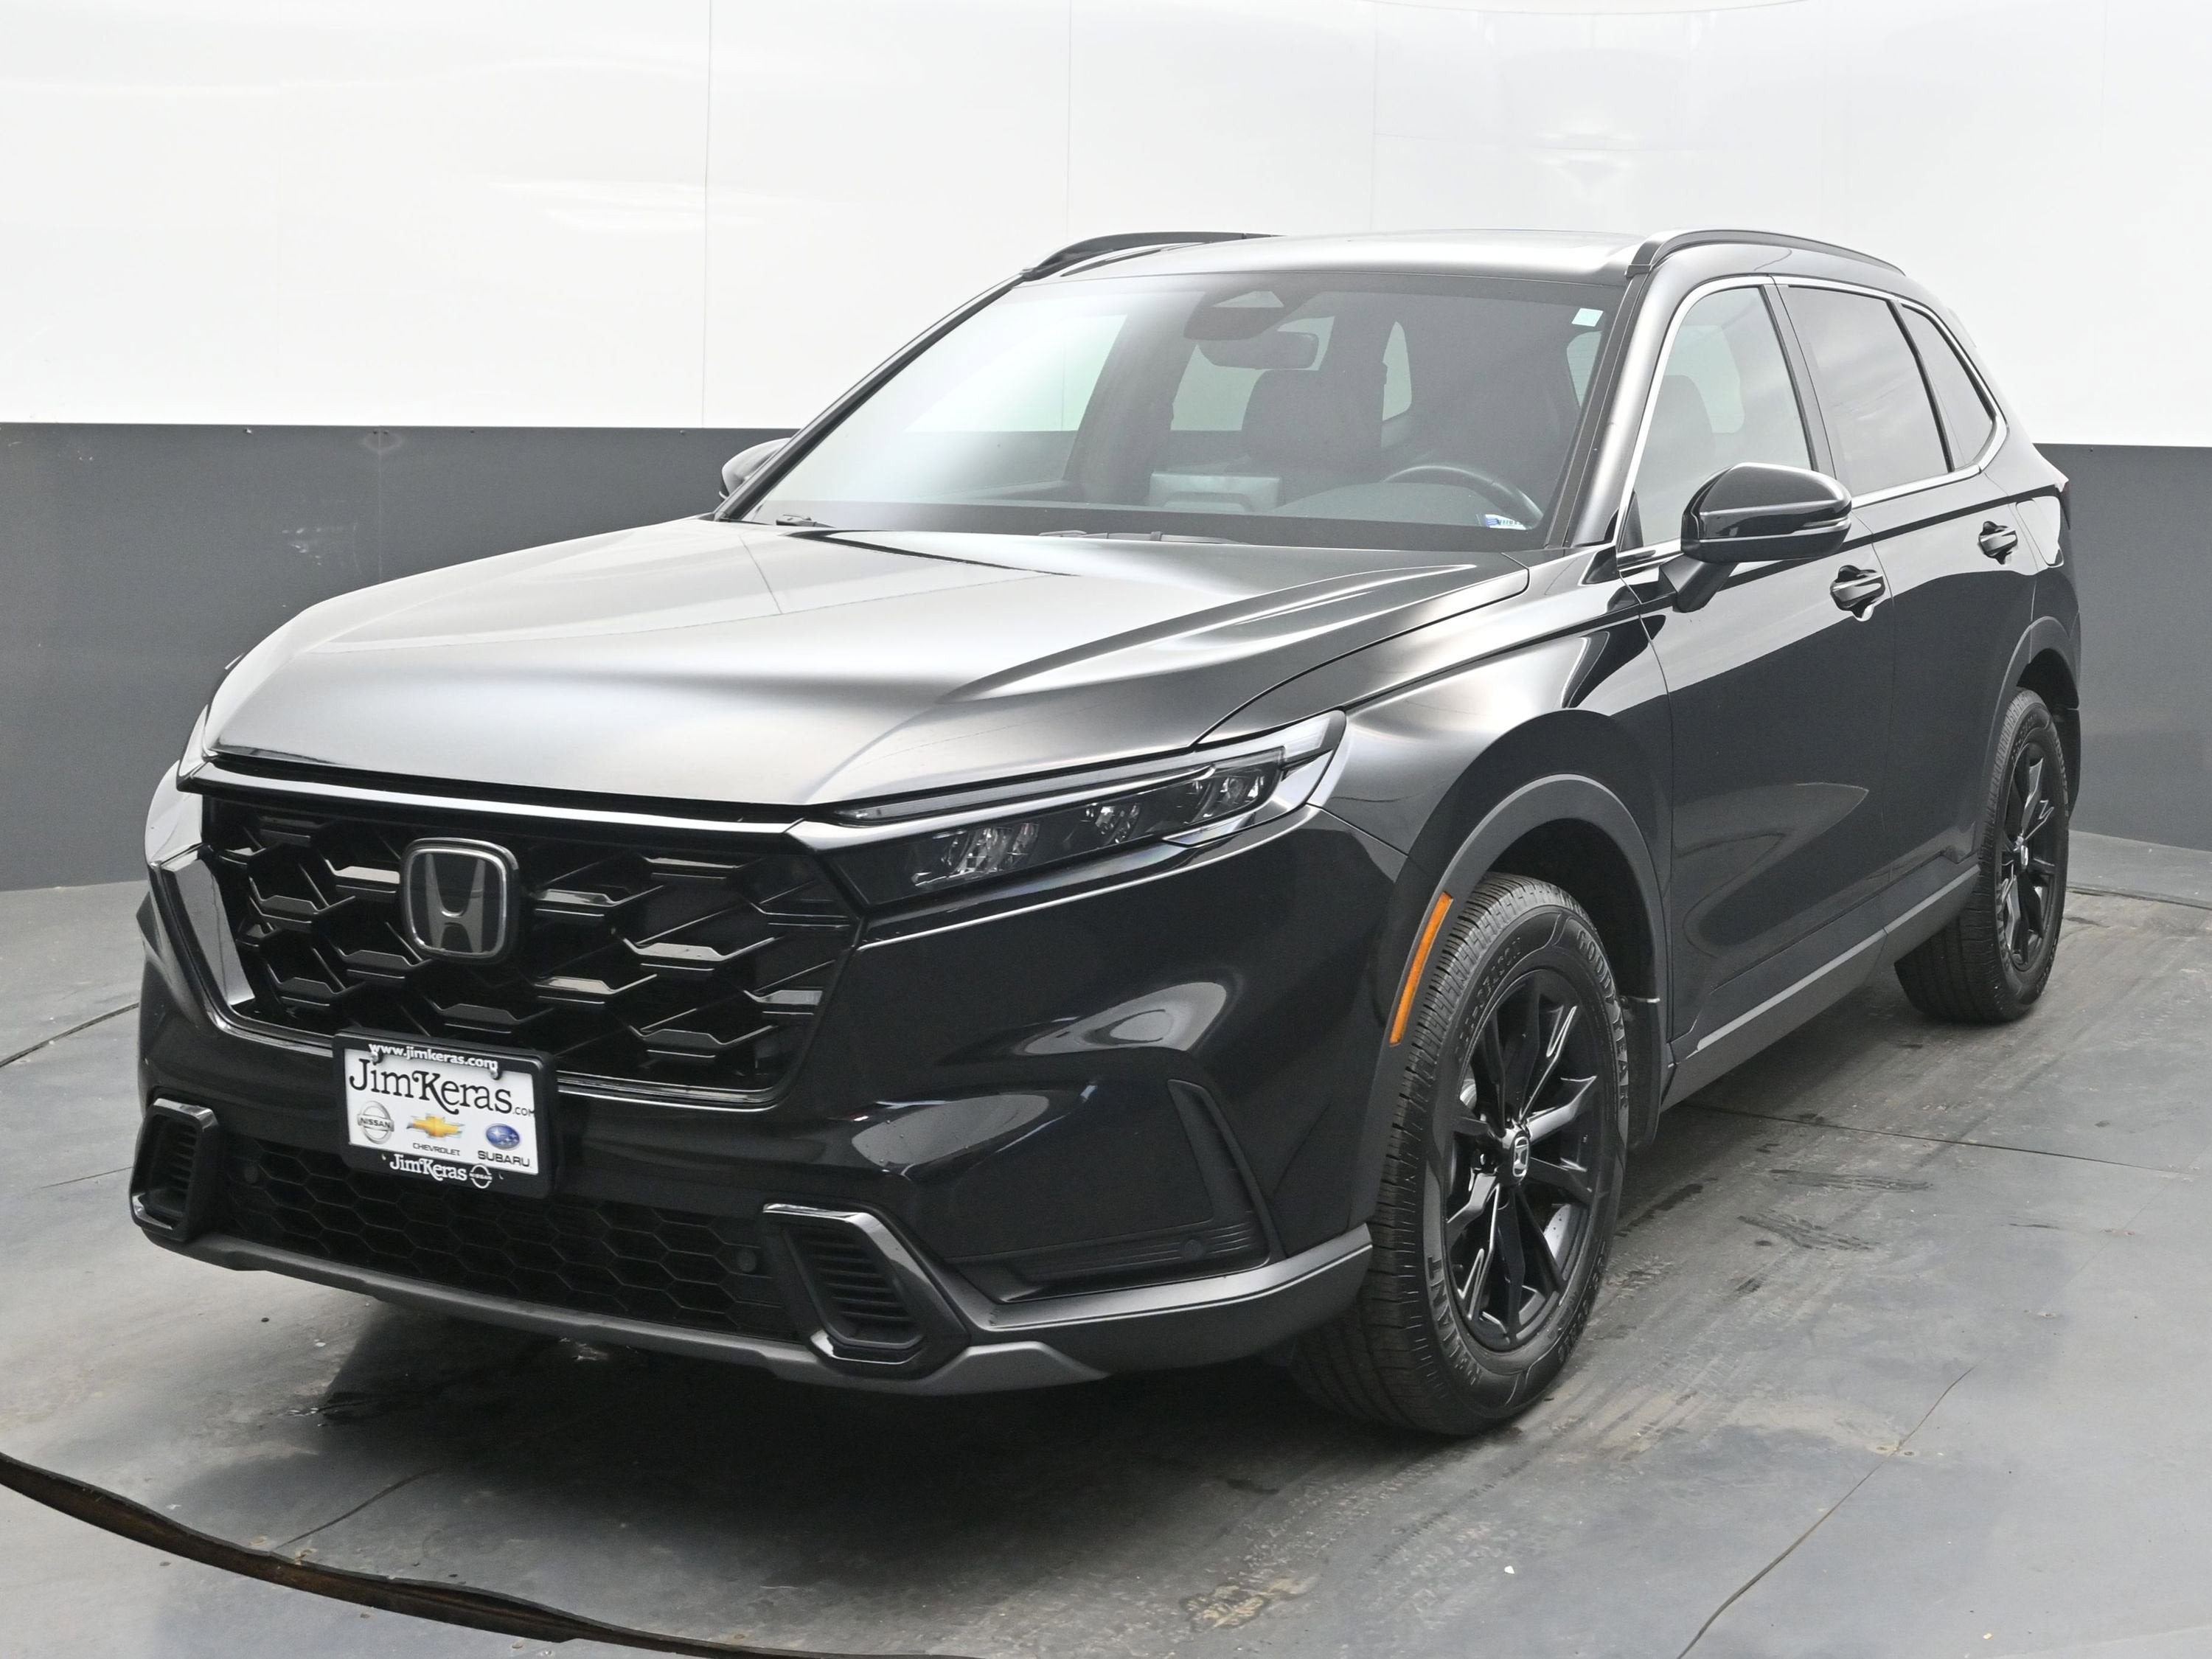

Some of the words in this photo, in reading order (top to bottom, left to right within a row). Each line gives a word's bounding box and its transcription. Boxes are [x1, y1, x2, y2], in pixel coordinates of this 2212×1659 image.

[368, 1043, 498, 1070] www.jimkeras.com
[360, 1116, 392, 1129] NISSAN
[412, 1142, 461, 1156] CHEVROLET
[477, 1150, 531, 1167] SUBARU
